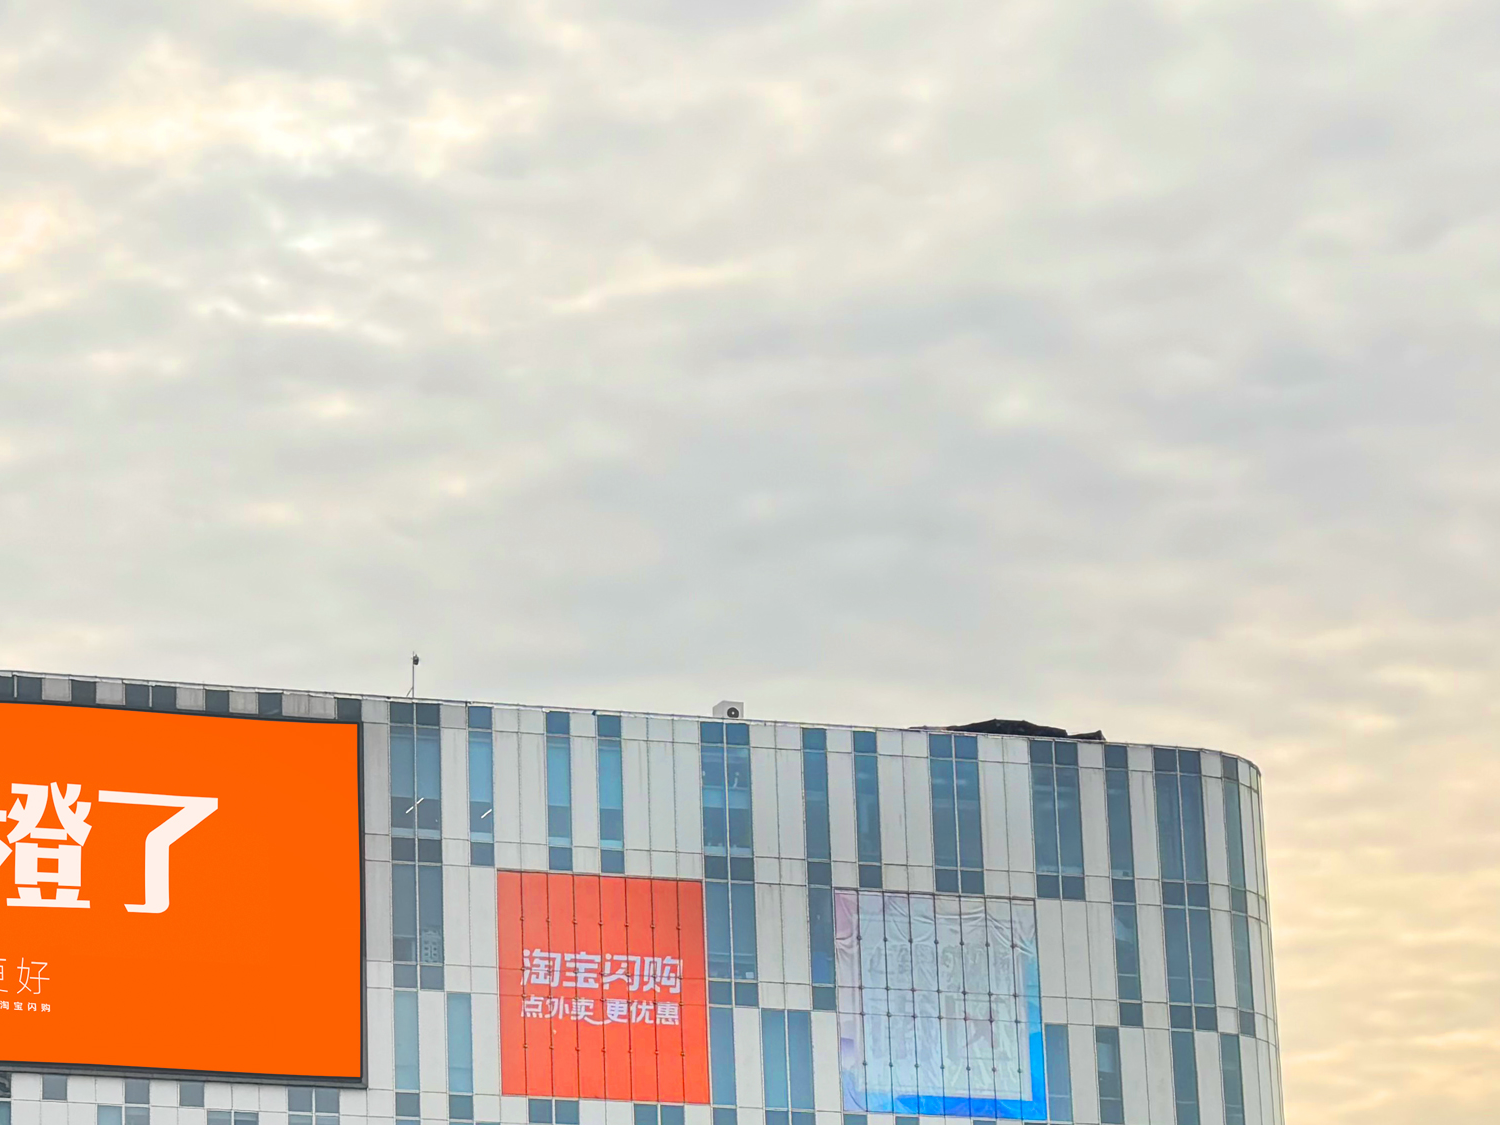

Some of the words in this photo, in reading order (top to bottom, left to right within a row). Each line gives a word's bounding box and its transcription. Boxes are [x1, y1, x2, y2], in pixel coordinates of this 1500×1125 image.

[520, 948, 684, 994] 淘宝闪购
[520, 993, 595, 1021] 点外卖
[605, 998, 680, 1026] 更优惠
